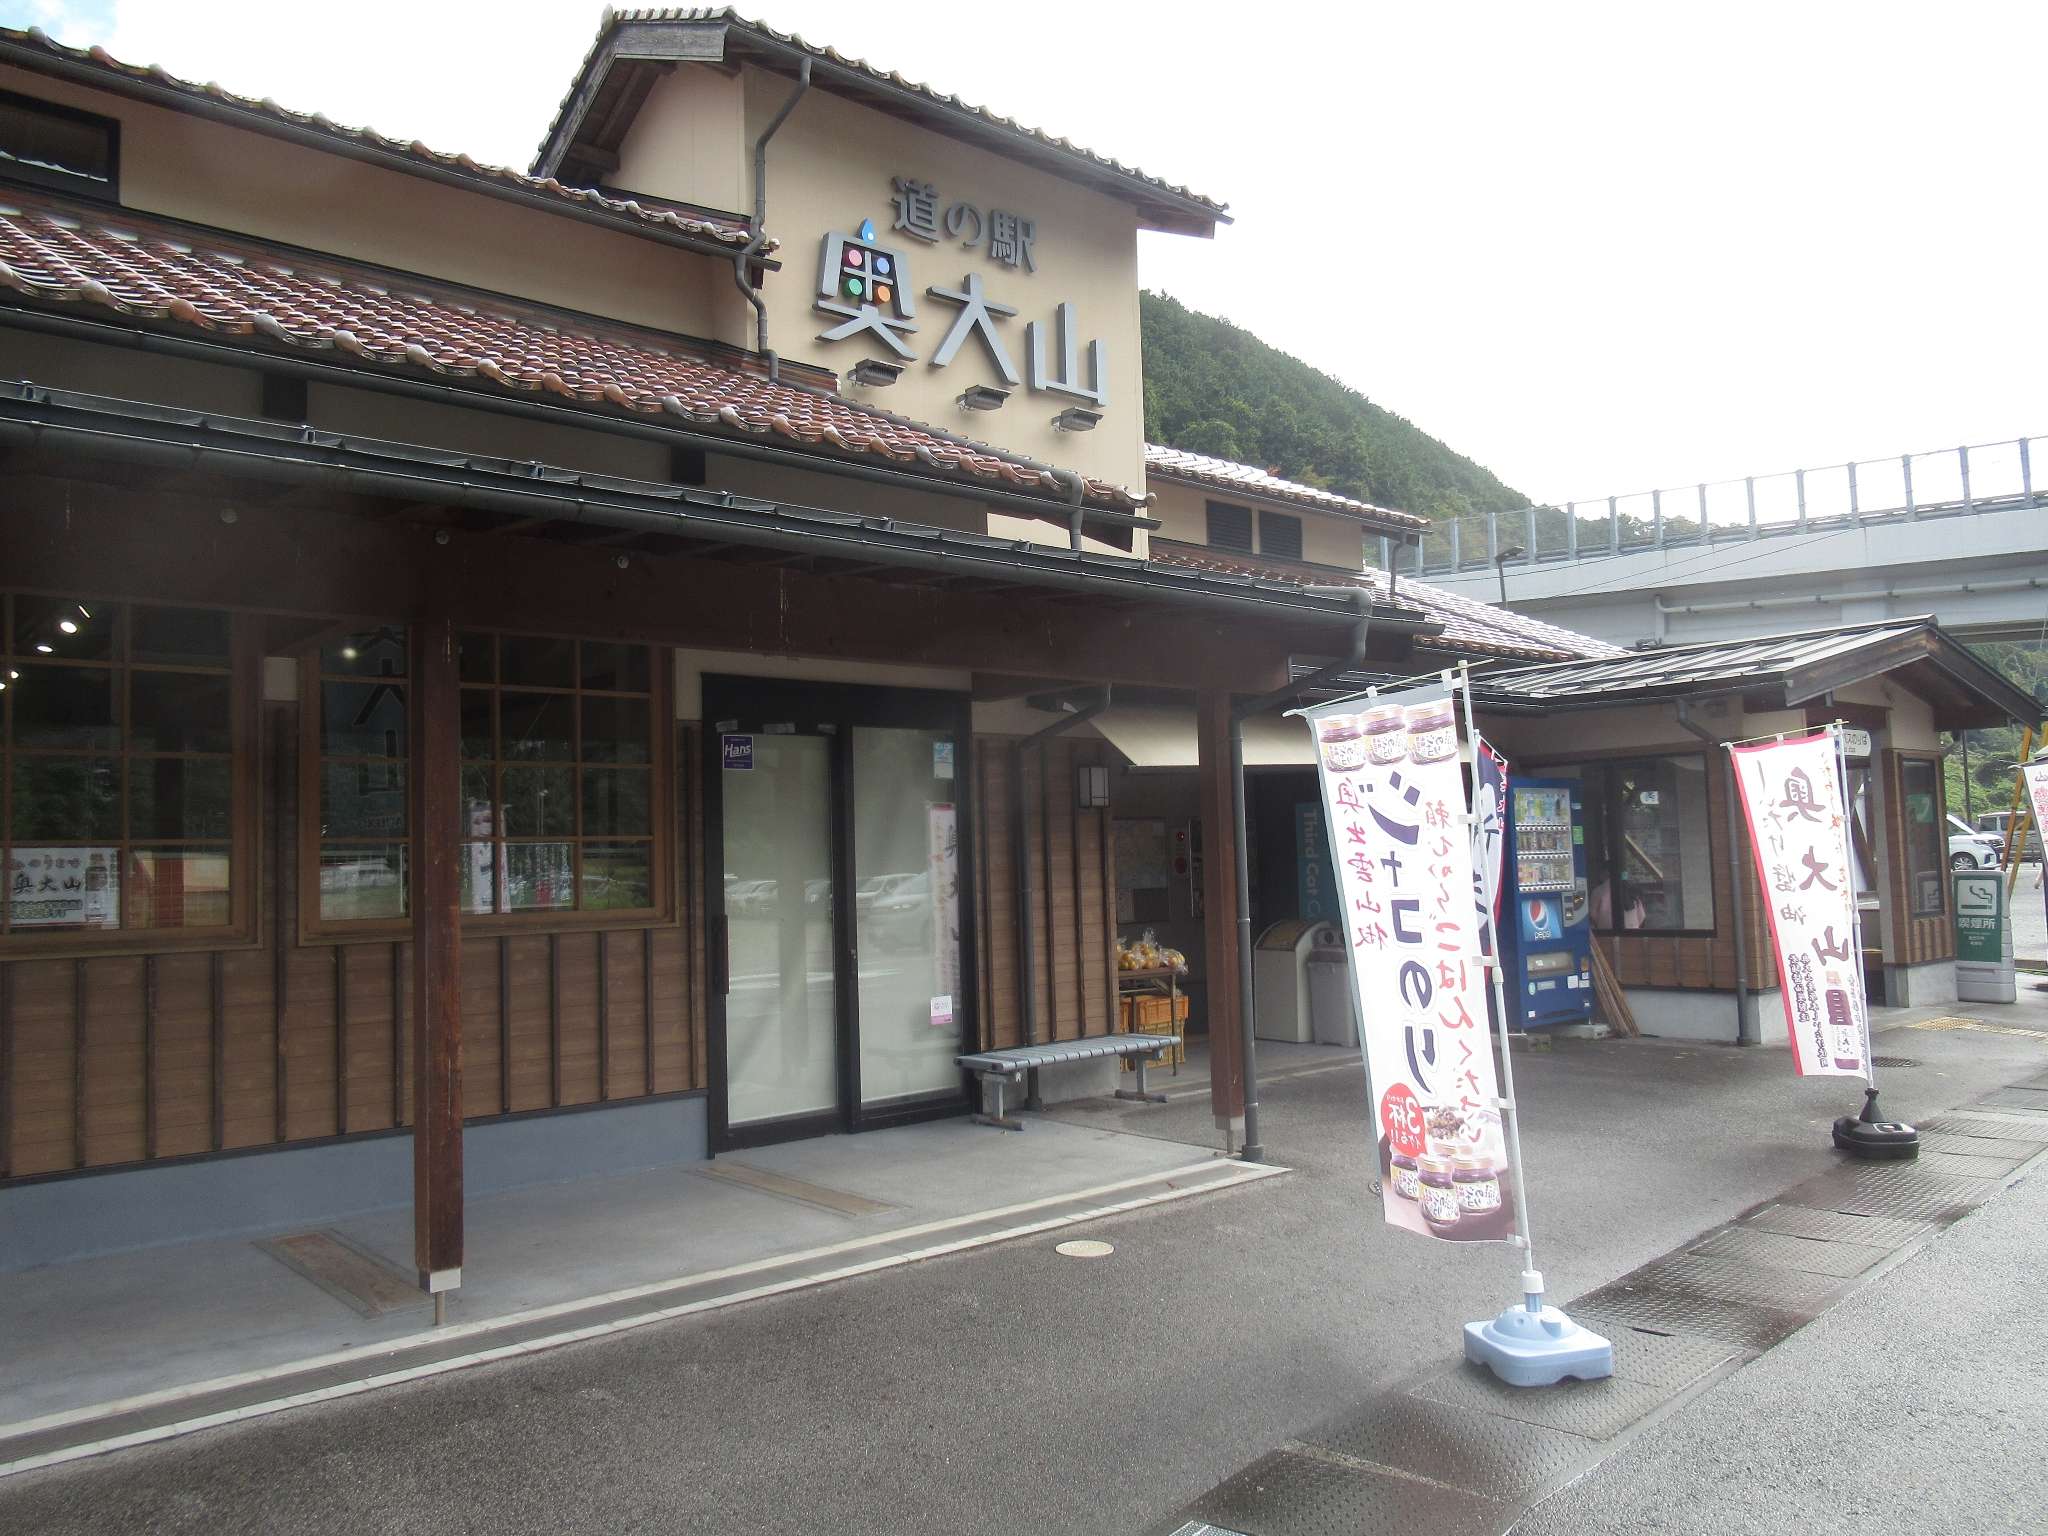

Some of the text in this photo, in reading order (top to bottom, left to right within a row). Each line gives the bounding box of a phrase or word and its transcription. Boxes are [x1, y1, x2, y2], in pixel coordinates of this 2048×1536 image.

[891, 174, 1038, 273] 道の駅
[813, 219, 1107, 407] 奥大山
[725, 744, 752, 757] Hans
